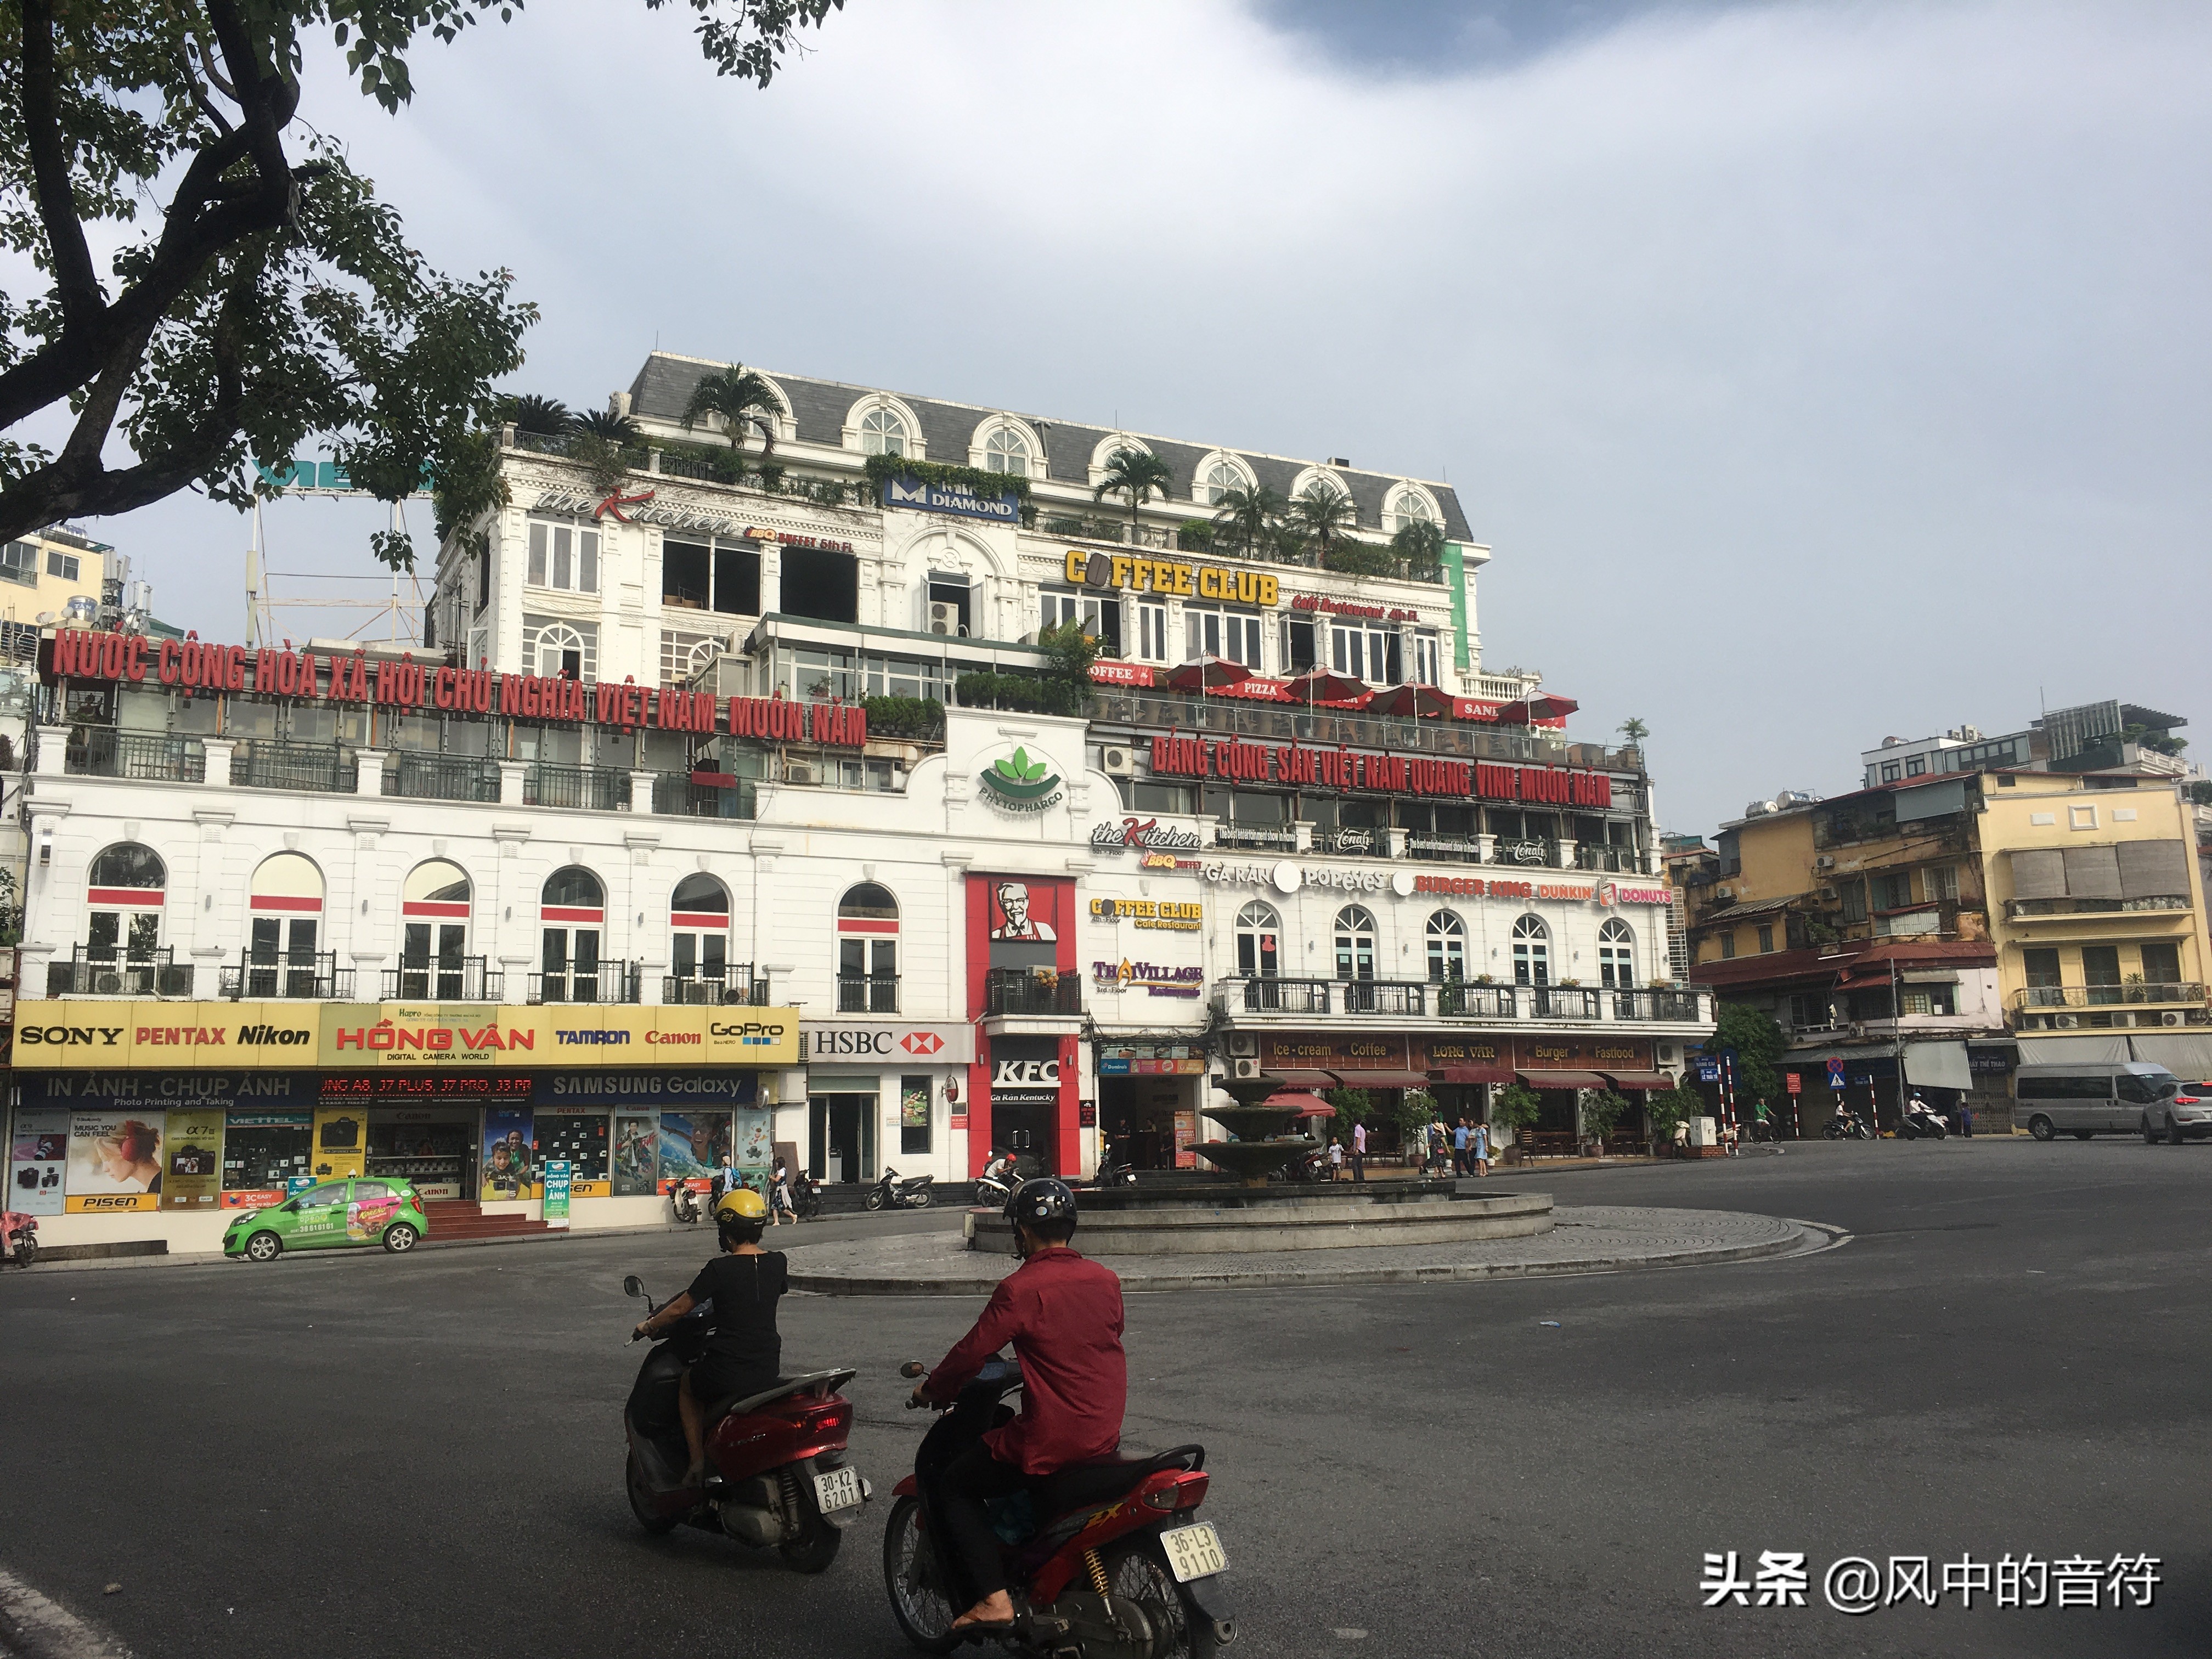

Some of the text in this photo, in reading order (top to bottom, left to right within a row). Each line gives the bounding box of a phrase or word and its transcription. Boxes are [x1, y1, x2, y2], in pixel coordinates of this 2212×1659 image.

[595, 486, 736, 534] Kitchen
[933, 494, 1012, 515] DIAMOND
[749, 529, 776, 541] BBQ
[778, 533, 817, 547] BUFFET
[1199, 567, 1279, 606] CLUB
[1320, 597, 1385, 619] Restaurant
[53, 621, 867, 747] NƯỚC CỘNG HÒA XÃ HỘI CHỦ NGHĨA VIỆT NAM MUÔN NĂM
[1244, 682, 1278, 696] PIZZA
[1152, 725, 1612, 809] ĐẢNG CỘNG SẢN VIỆT NAM QUANG VINH MUÔN NĂM
[979, 786, 1063, 812] PHYTOPHARCO
[1122, 817, 1202, 848] Kitchen
[1227, 828, 1237, 839] best
[1417, 838, 1426, 850] best
[1147, 854, 1177, 870] BBQ
[1206, 861, 1232, 882] GÀ
[1235, 863, 1270, 884] RÁN
[1415, 874, 1485, 896] BURGER
[1491, 880, 1532, 899] KING
[1539, 884, 1595, 901] DUNKIN'
[1620, 887, 1673, 904] DONUTS
[1160, 901, 1202, 919] CLUB
[1157, 920, 1202, 930] Restaurant
[399, 1008, 421, 1017] Hapro
[20, 1018, 784, 1051] SONY PENTAX Nikon HỒNG VÂN TAMRON Canon GoPro
[815, 1030, 893, 1055] HSBC
[1273, 1042, 1634, 1062] Ice cream Coffee LONG Burger Fastfood
[996, 1060, 1060, 1082] KFC
[47, 1076, 72, 1096] IN
[83, 1070, 139, 1096] ẢNH
[170, 1076, 229, 1099] CHỤP
[236, 1070, 291, 1096] ẢNH
[554, 1076, 742, 1098] SAMSUNG Galaxy
[145, 1098, 181, 1108] Printing
[206, 1097, 234, 1107] Taking
[1019, 1094, 1056, 1102] Kentucky
[229, 1116, 294, 1124] VIETTEL
[397, 1111, 431, 1120] Canon
[417, 1187, 449, 1196] Canon
[546, 1180, 568, 1190] CHỤP
[570, 1184, 592, 1193] SEN
[83, 1197, 137, 1207] PISEN
[245, 1194, 257, 1203] 3C
[549, 1189, 565, 1200] ẢNH
[359, 1207, 386, 1219] KORENO
[825, 1487, 855, 1509] 6201
[1180, 1549, 1221, 1576] 9110
